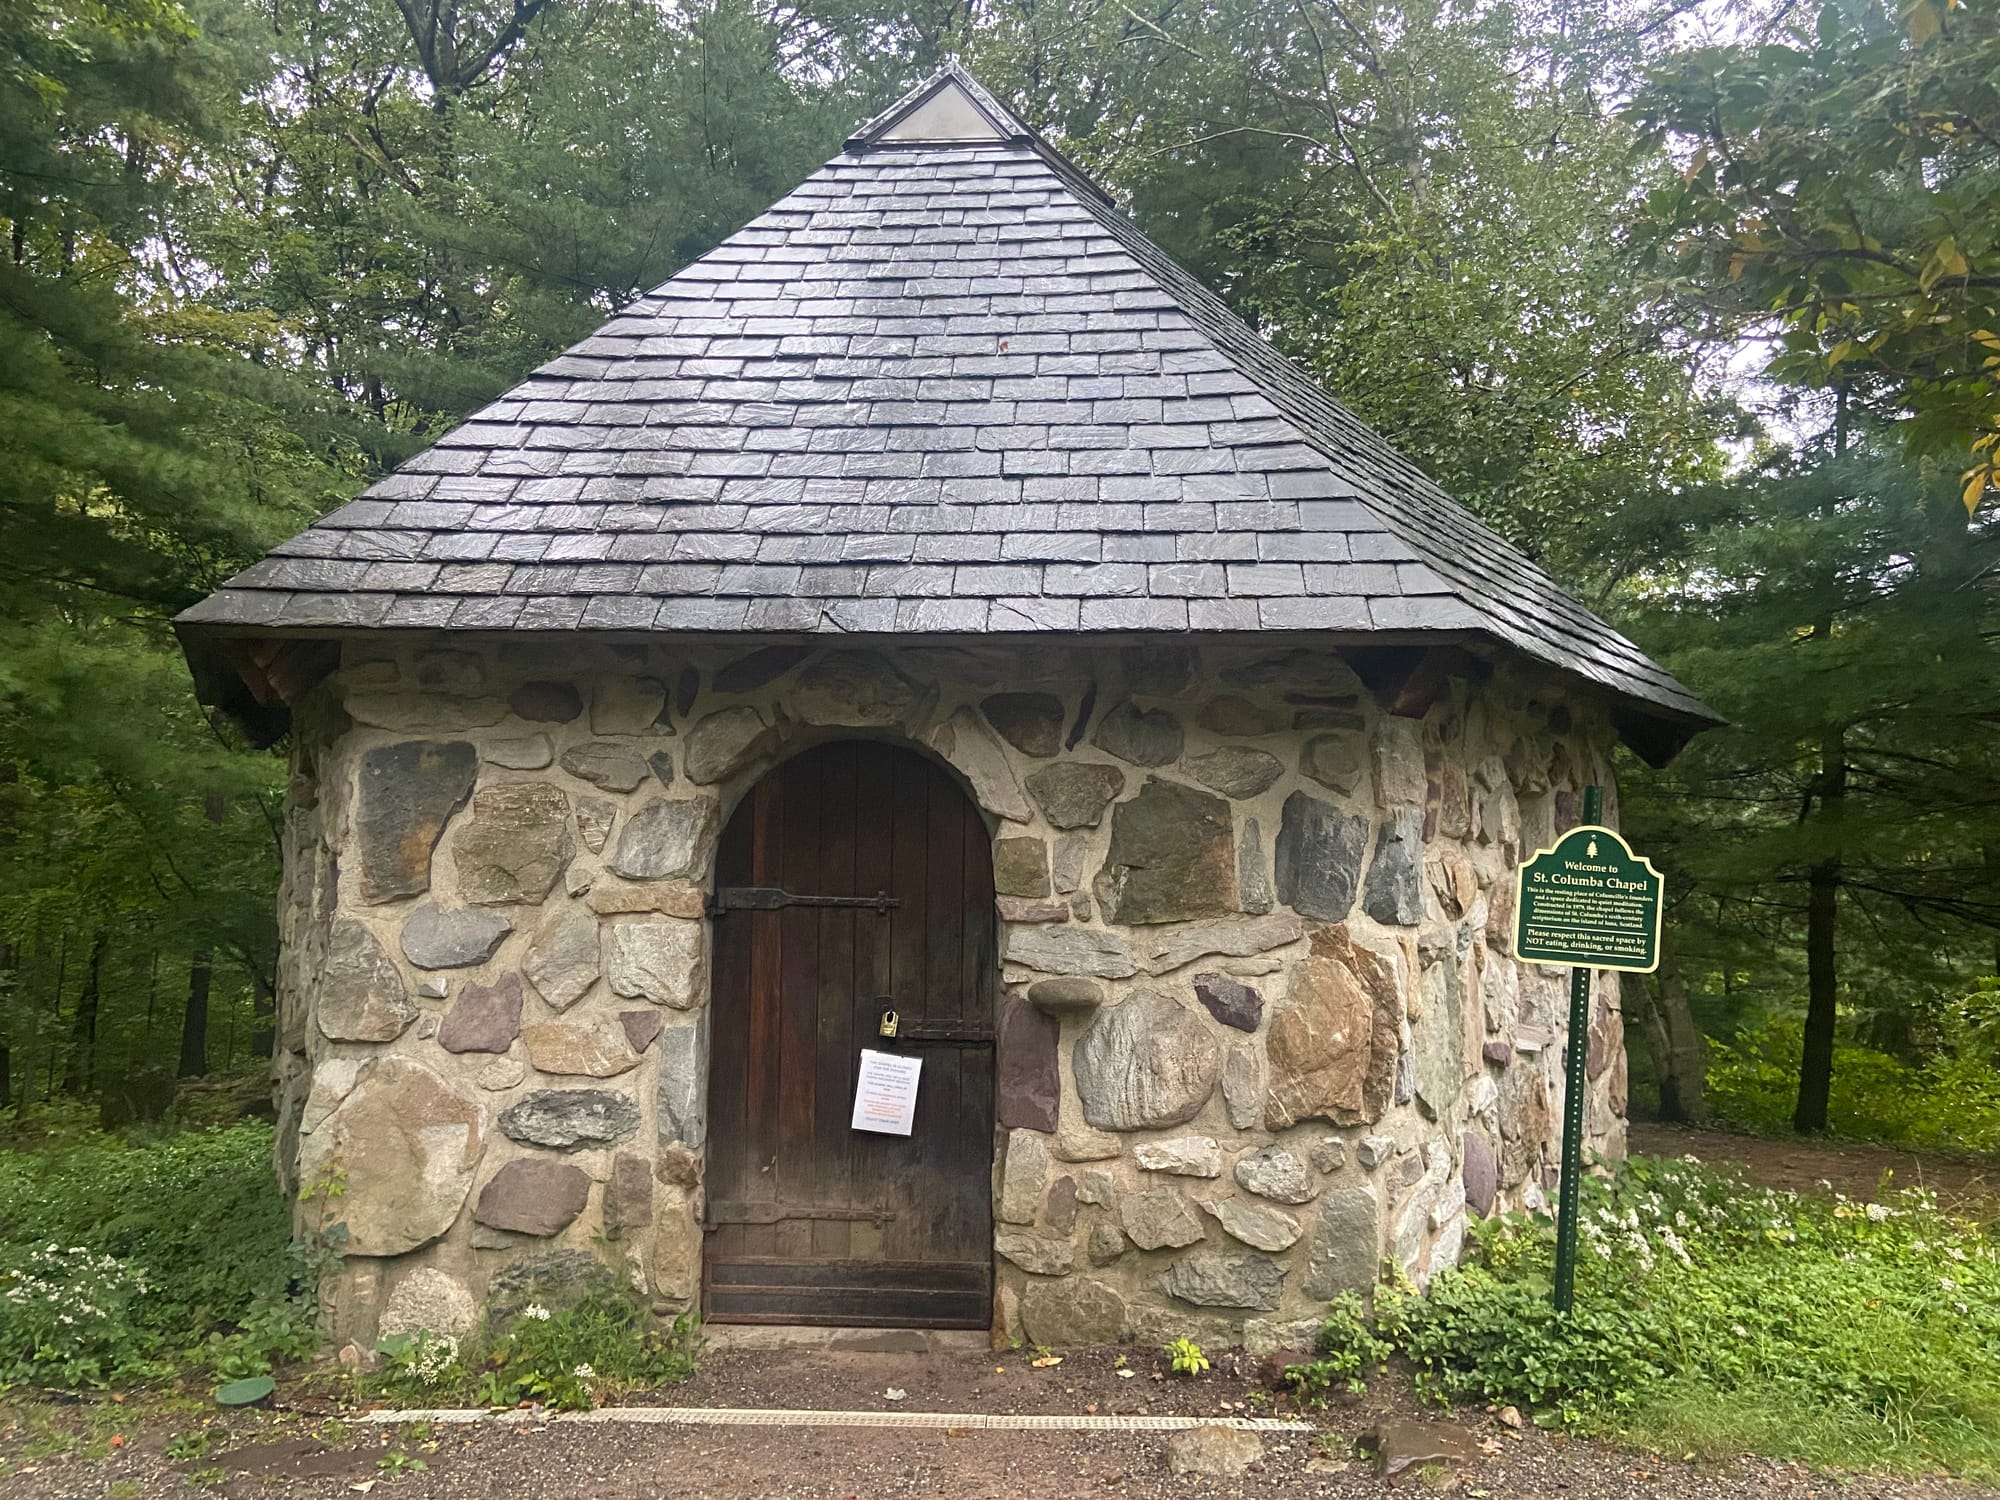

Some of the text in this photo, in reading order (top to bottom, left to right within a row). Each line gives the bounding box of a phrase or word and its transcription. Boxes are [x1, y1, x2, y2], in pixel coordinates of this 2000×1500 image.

[1565, 861, 1618, 874] Welcome to
[1533, 872, 1647, 893] St. Columba Chapel
[1526, 937, 1544, 945] NOT
[1545, 939, 1569, 949] eating,
[1570, 941, 1603, 951] drinking,
[1528, 928, 1550, 937] Please
[1551, 931, 1576, 940] respect
[1616, 937, 1636, 945] space
[1637, 937, 1646, 947] by
